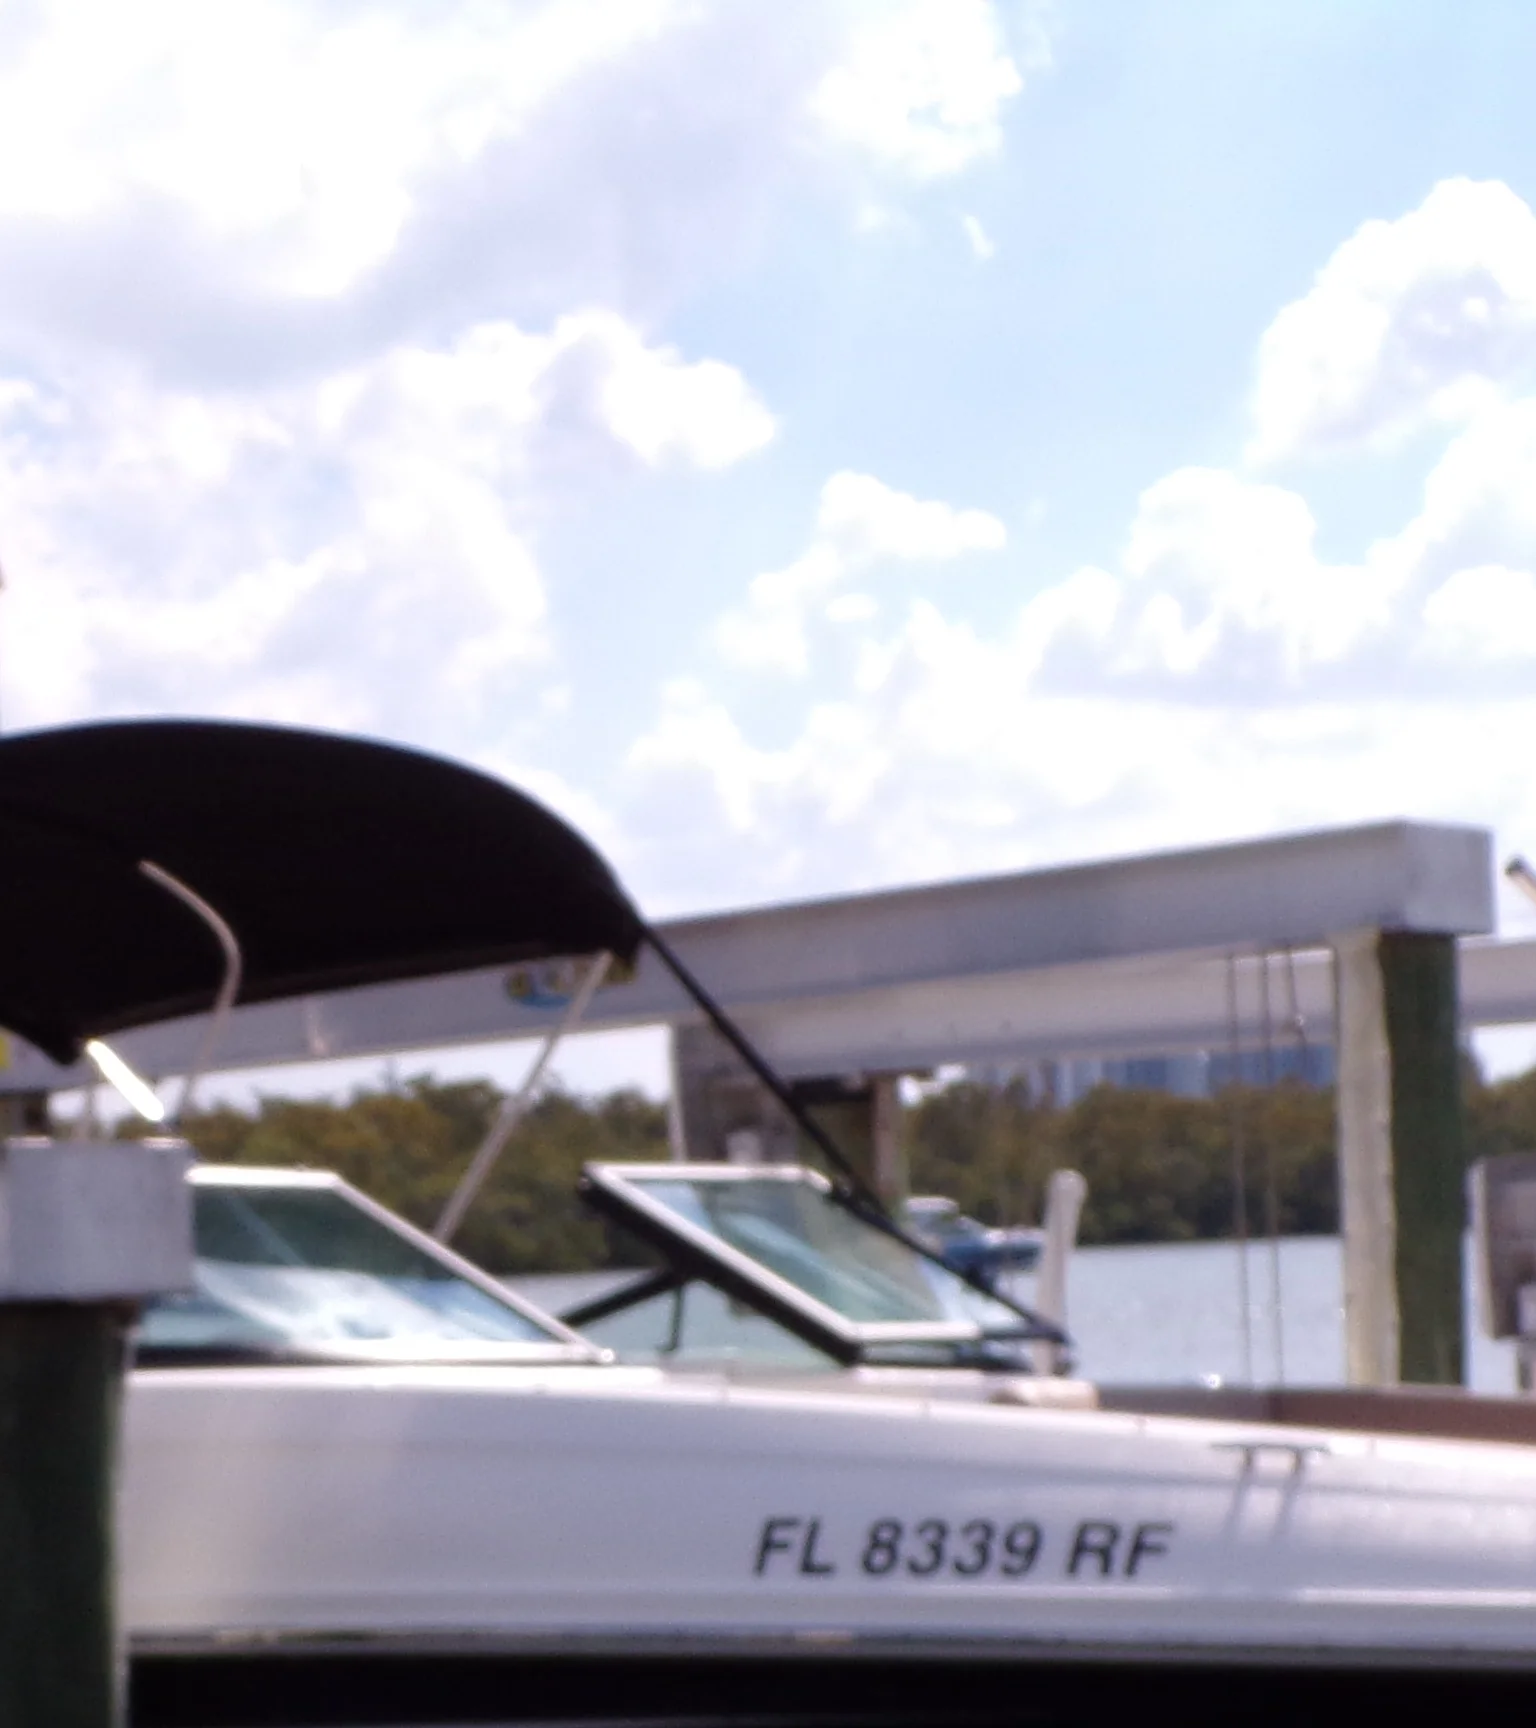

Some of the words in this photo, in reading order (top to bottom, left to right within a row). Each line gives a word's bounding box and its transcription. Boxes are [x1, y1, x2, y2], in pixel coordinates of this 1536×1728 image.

[753, 1517, 835, 1578] FL
[862, 1517, 1044, 1579] 8339
[1067, 1520, 1173, 1579] RF
